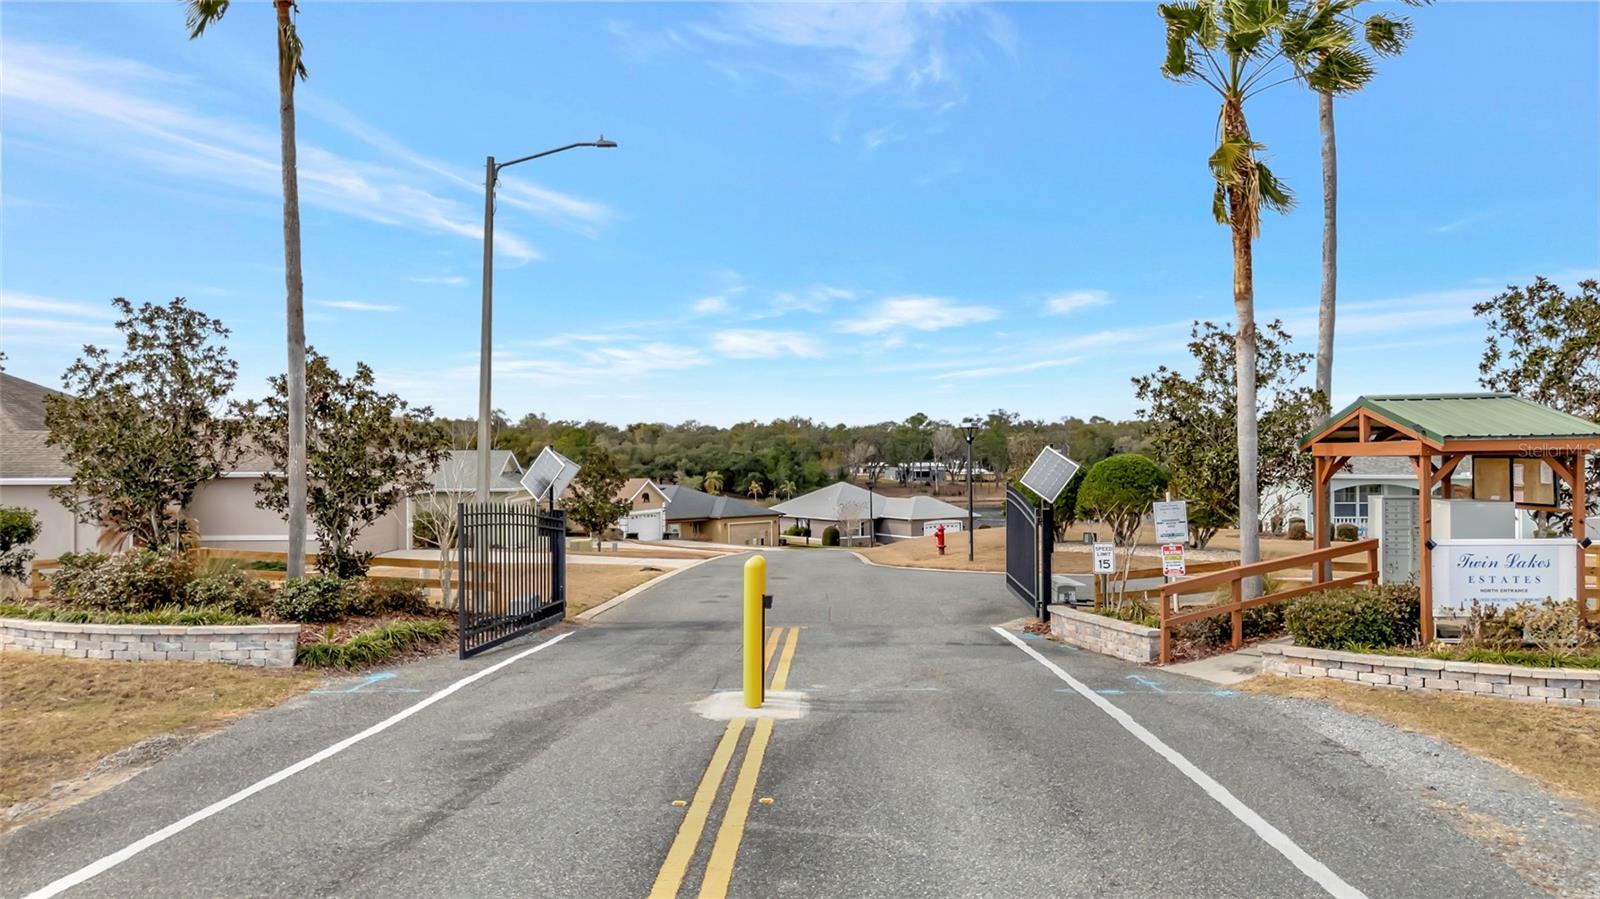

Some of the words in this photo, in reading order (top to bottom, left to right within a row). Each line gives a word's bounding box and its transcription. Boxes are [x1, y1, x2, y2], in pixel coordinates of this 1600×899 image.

[1099, 559, 1111, 569] 15
[1457, 553, 1499, 569] Twin
[1504, 552, 1551, 569] Lakes
[1468, 575, 1542, 584] ESTATES
